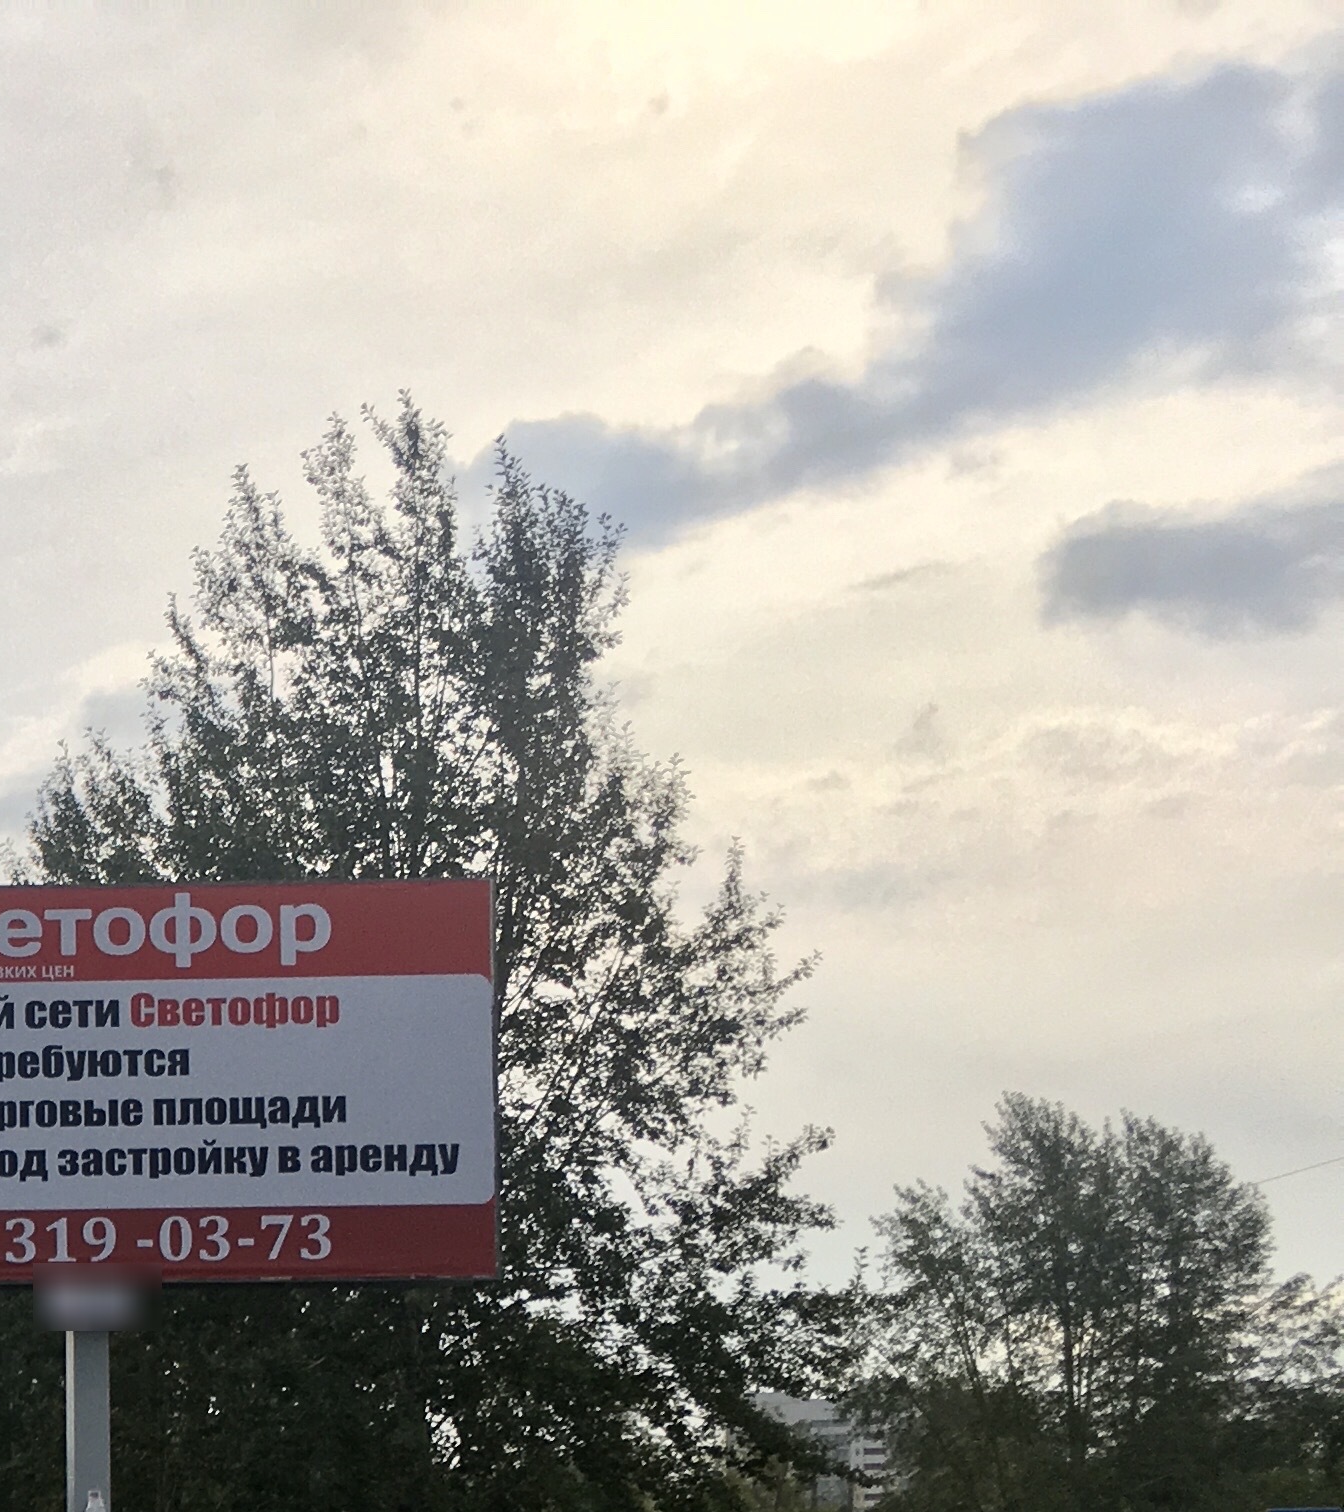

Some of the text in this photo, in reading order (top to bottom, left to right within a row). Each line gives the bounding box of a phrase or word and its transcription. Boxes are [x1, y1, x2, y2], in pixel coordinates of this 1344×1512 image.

[41, 965, 74, 981] ЦЕН
[25, 999, 120, 1029] сети
[130, 992, 340, 1029] Светофор
[153, 1094, 347, 1129] площади
[57, 1138, 269, 1179] застройку
[278, 1146, 301, 1174] в
[310, 1143, 460, 1177] аренду
[5, 1216, 118, 1264] 319
[136, 1213, 332, 1263] -03-73
